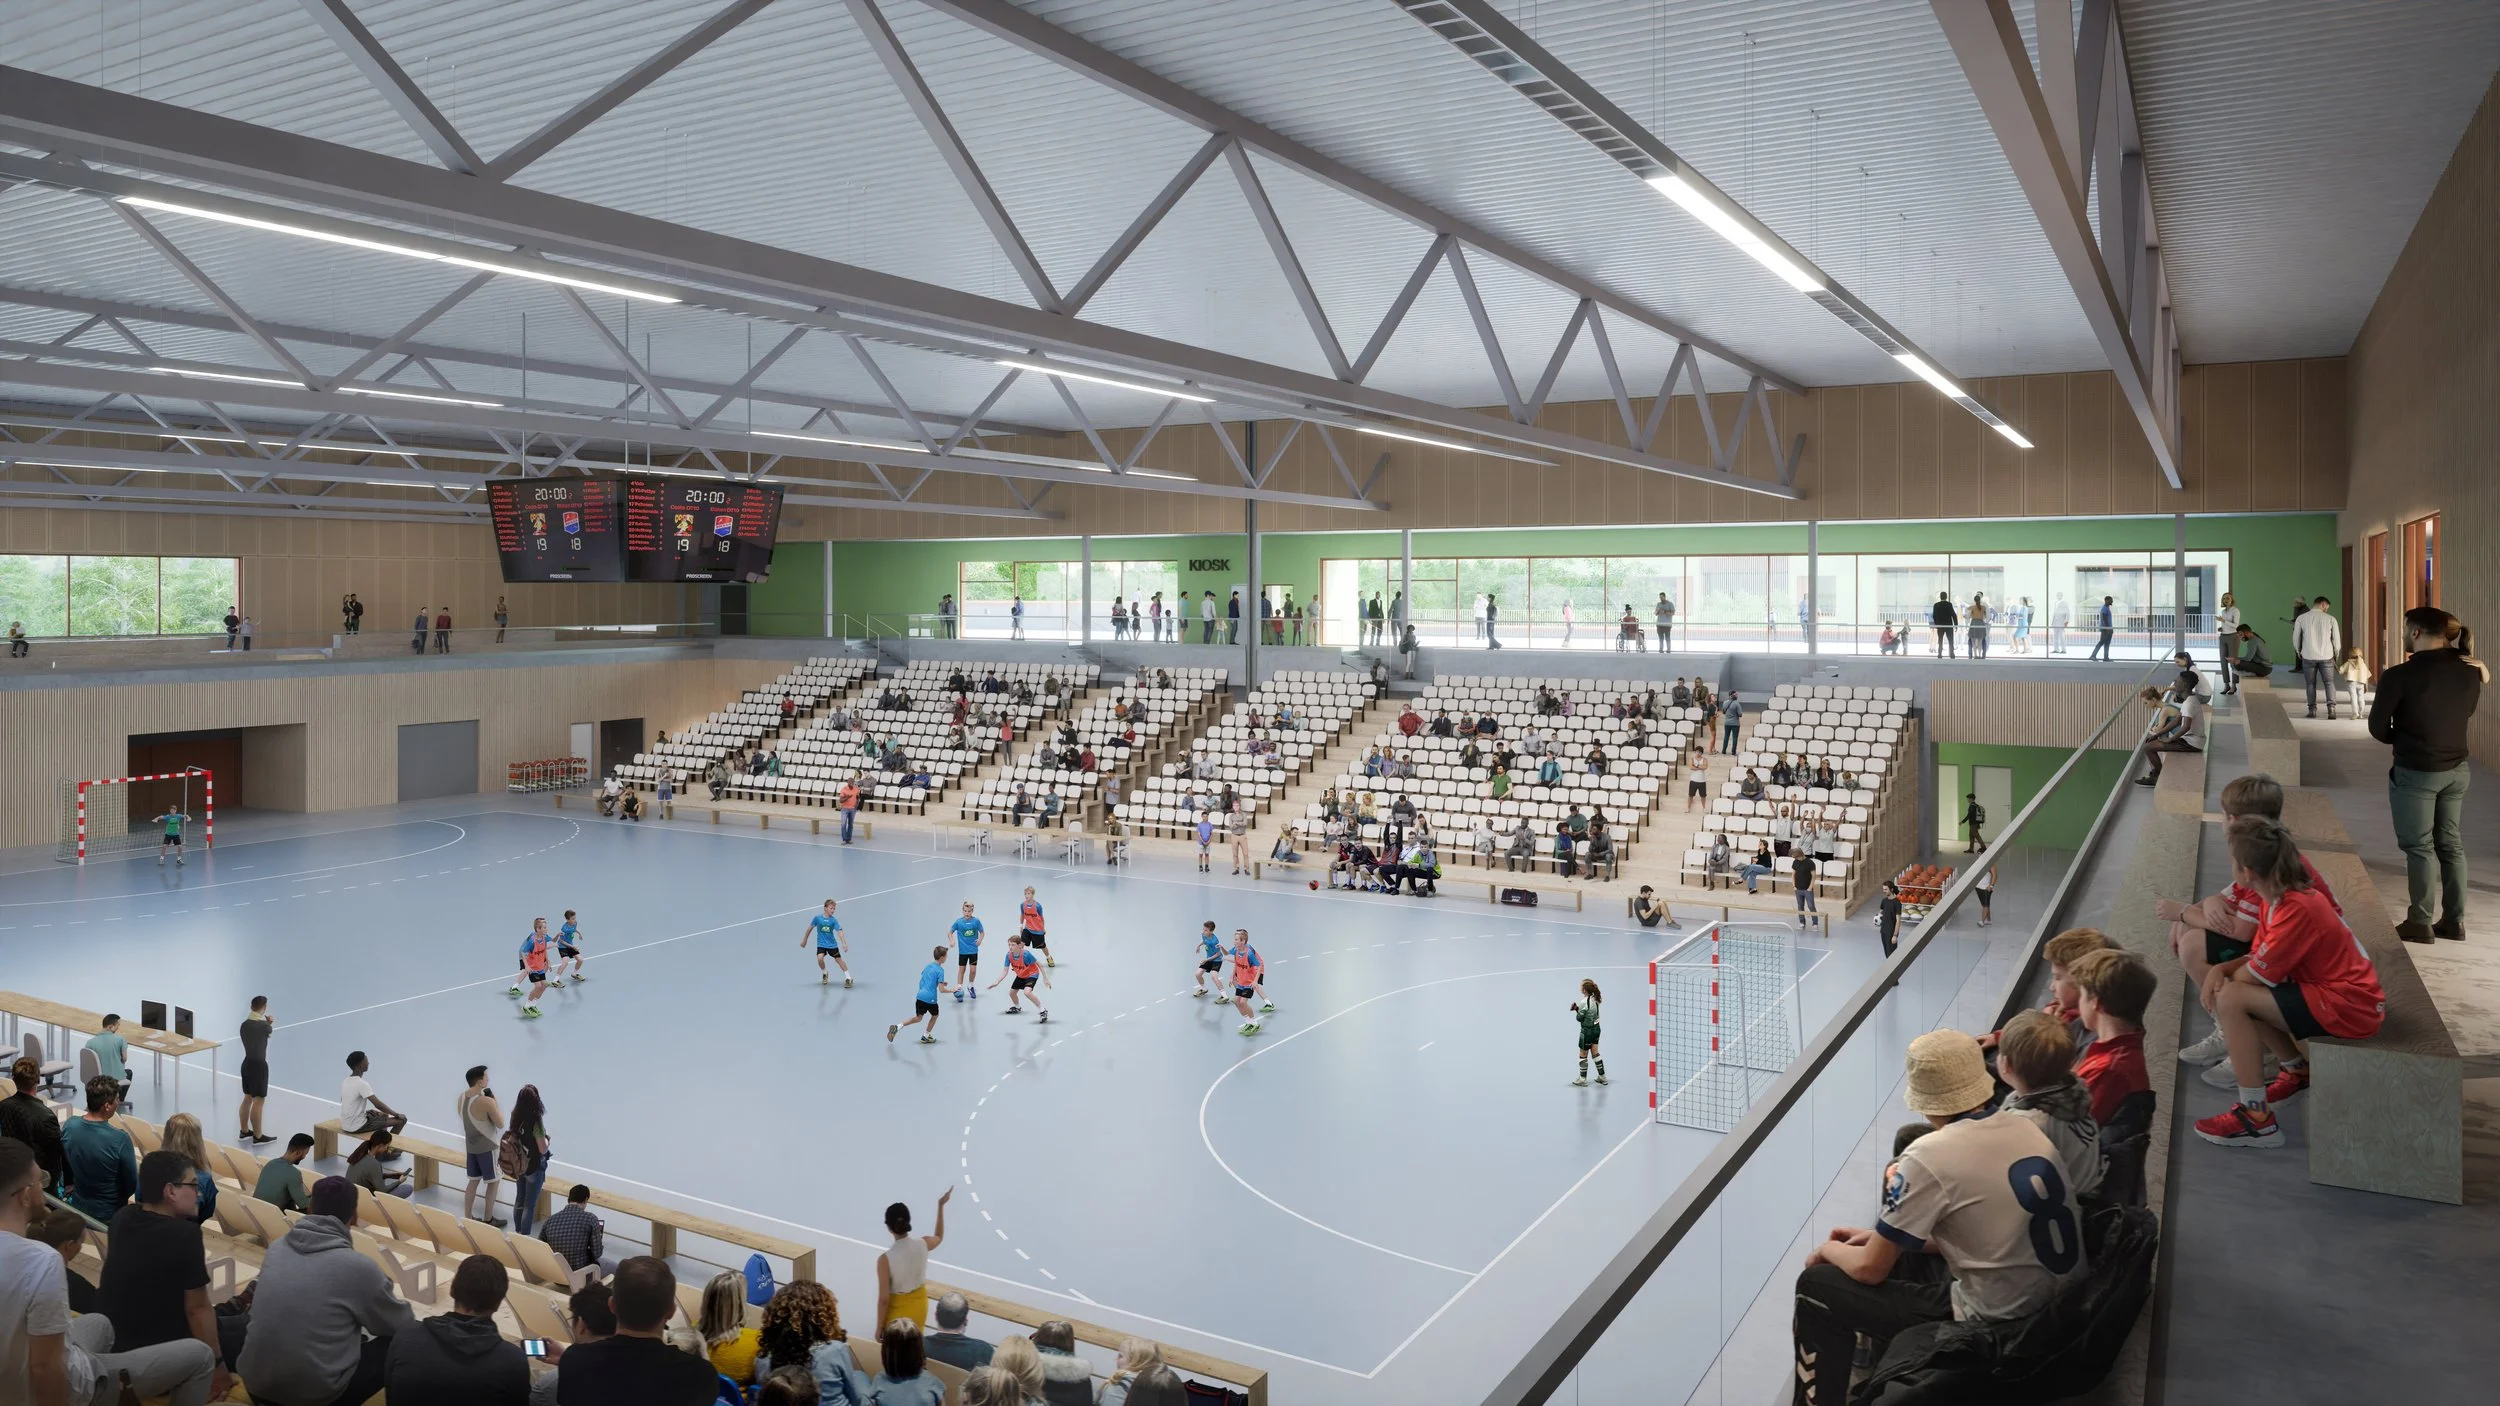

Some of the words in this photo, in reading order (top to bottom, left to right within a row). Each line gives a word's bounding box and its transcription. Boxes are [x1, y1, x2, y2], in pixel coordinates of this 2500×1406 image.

[535, 487, 567, 501] 20:00
[685, 490, 725, 504] 20:00
[536, 538, 548, 551] 19
[571, 537, 582, 551] 18
[677, 539, 690, 552] 19
[718, 540, 731, 553] 18
[1189, 559, 1230, 571] KIOSK
[2007, 1156, 2079, 1275] 8
